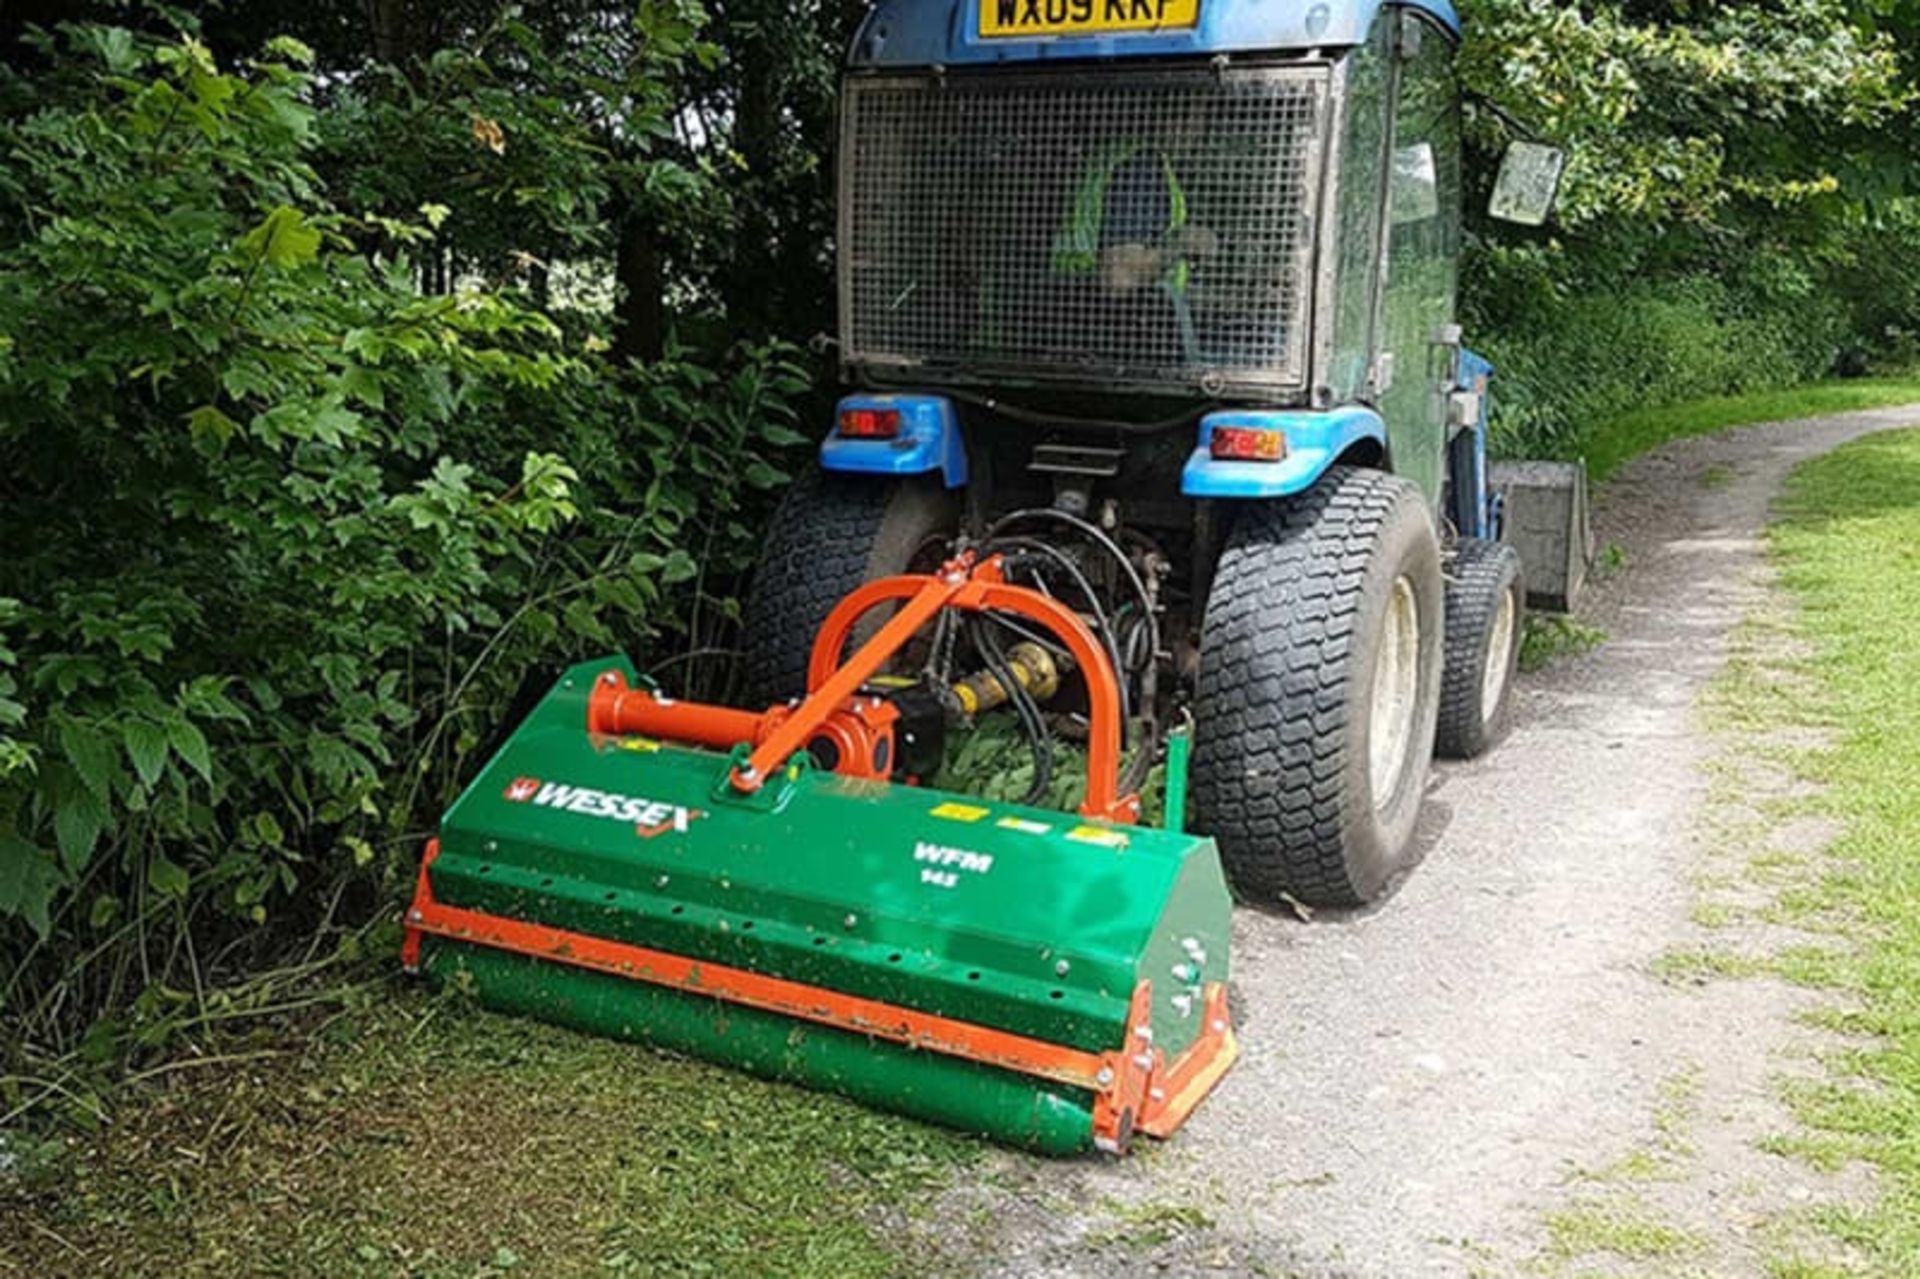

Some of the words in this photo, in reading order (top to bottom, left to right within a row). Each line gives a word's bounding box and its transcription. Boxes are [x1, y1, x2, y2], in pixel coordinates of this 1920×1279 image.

[997, 0, 1092, 26] WX09
[534, 782, 701, 836] WESSEX
[914, 841, 993, 873] WFM
